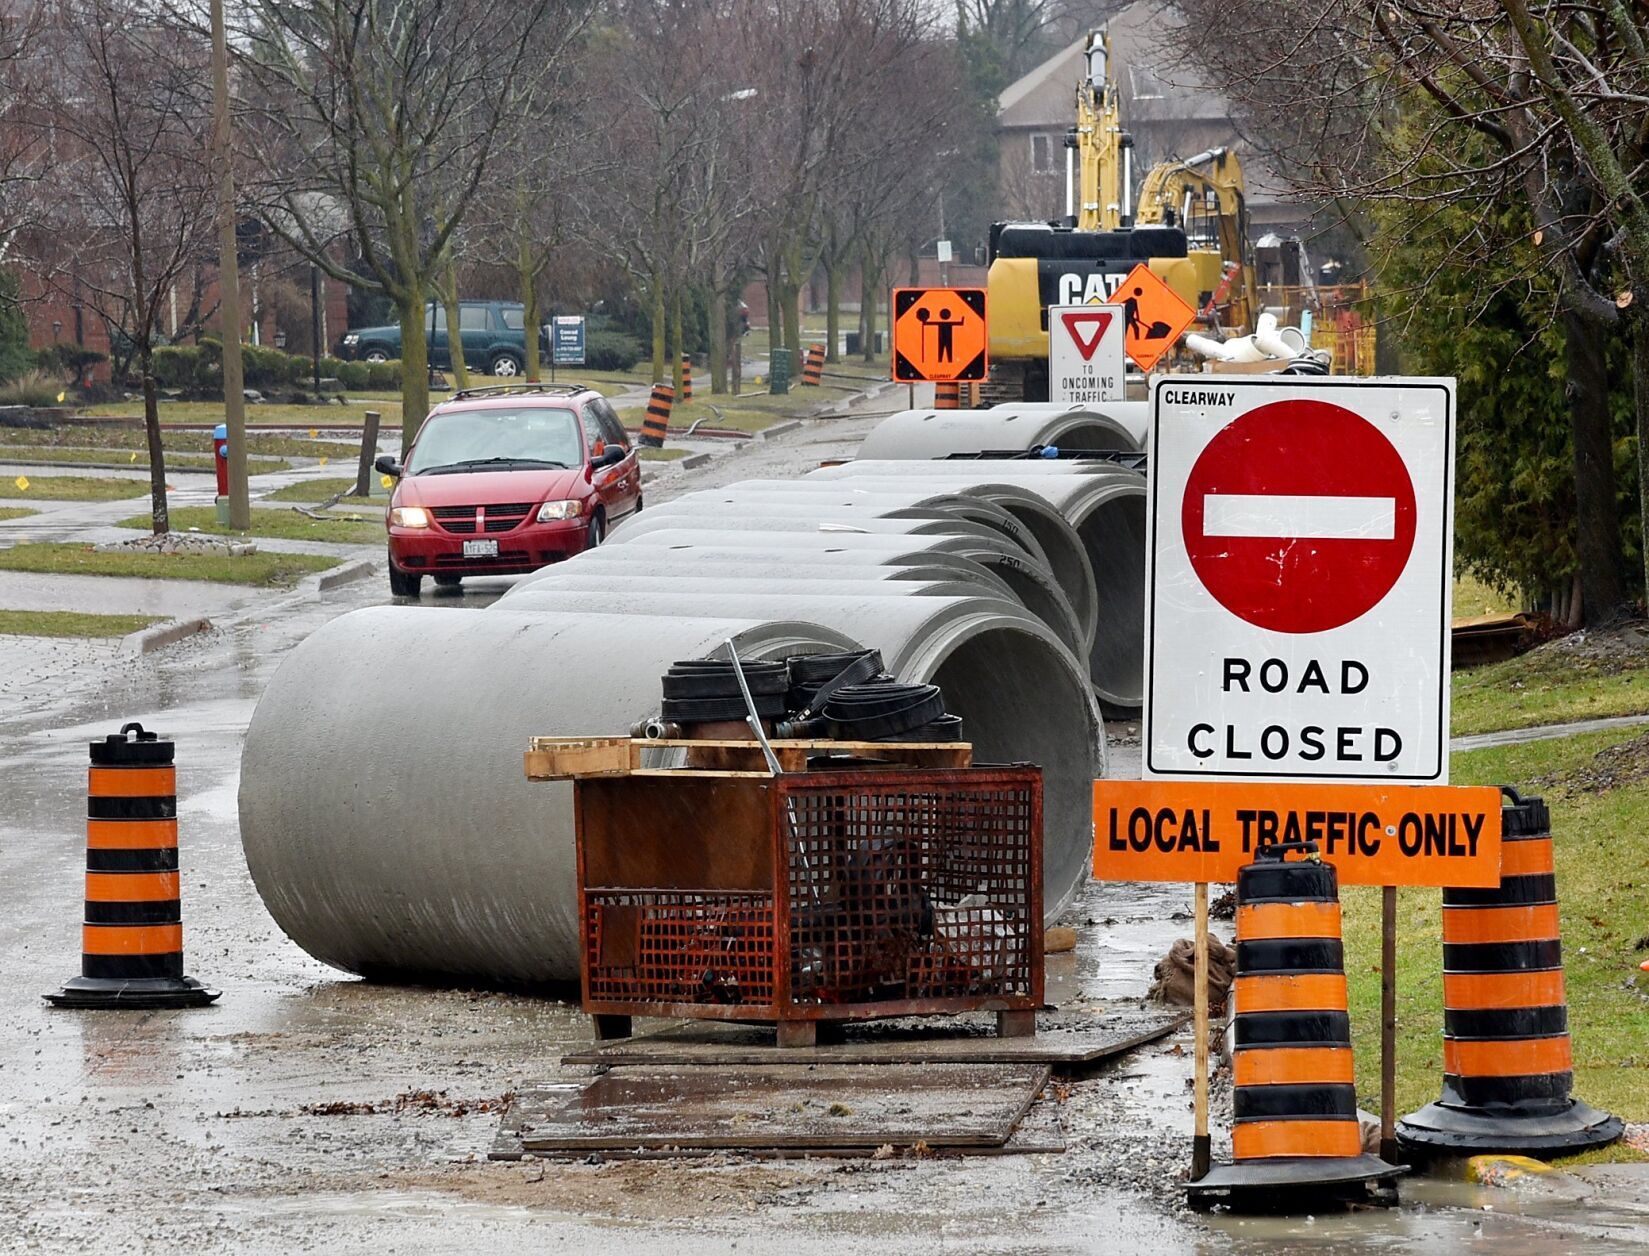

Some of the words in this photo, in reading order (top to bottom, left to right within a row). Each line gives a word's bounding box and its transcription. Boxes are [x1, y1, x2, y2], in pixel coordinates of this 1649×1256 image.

[1059, 273, 1128, 305] CAT
[1082, 365, 1093, 375] TO
[1062, 376, 1114, 390] ONCOMING
[1070, 391, 1107, 402] TRAFFIC
[1165, 390, 1236, 406] CLEARWAY
[1223, 657, 1369, 694] ROAD
[1187, 723, 1402, 762] CLOSED
[1109, 806, 1220, 853] LOCAL
[1236, 809, 1381, 857] TRAFFIC
[1398, 812, 1486, 857] ONLY
